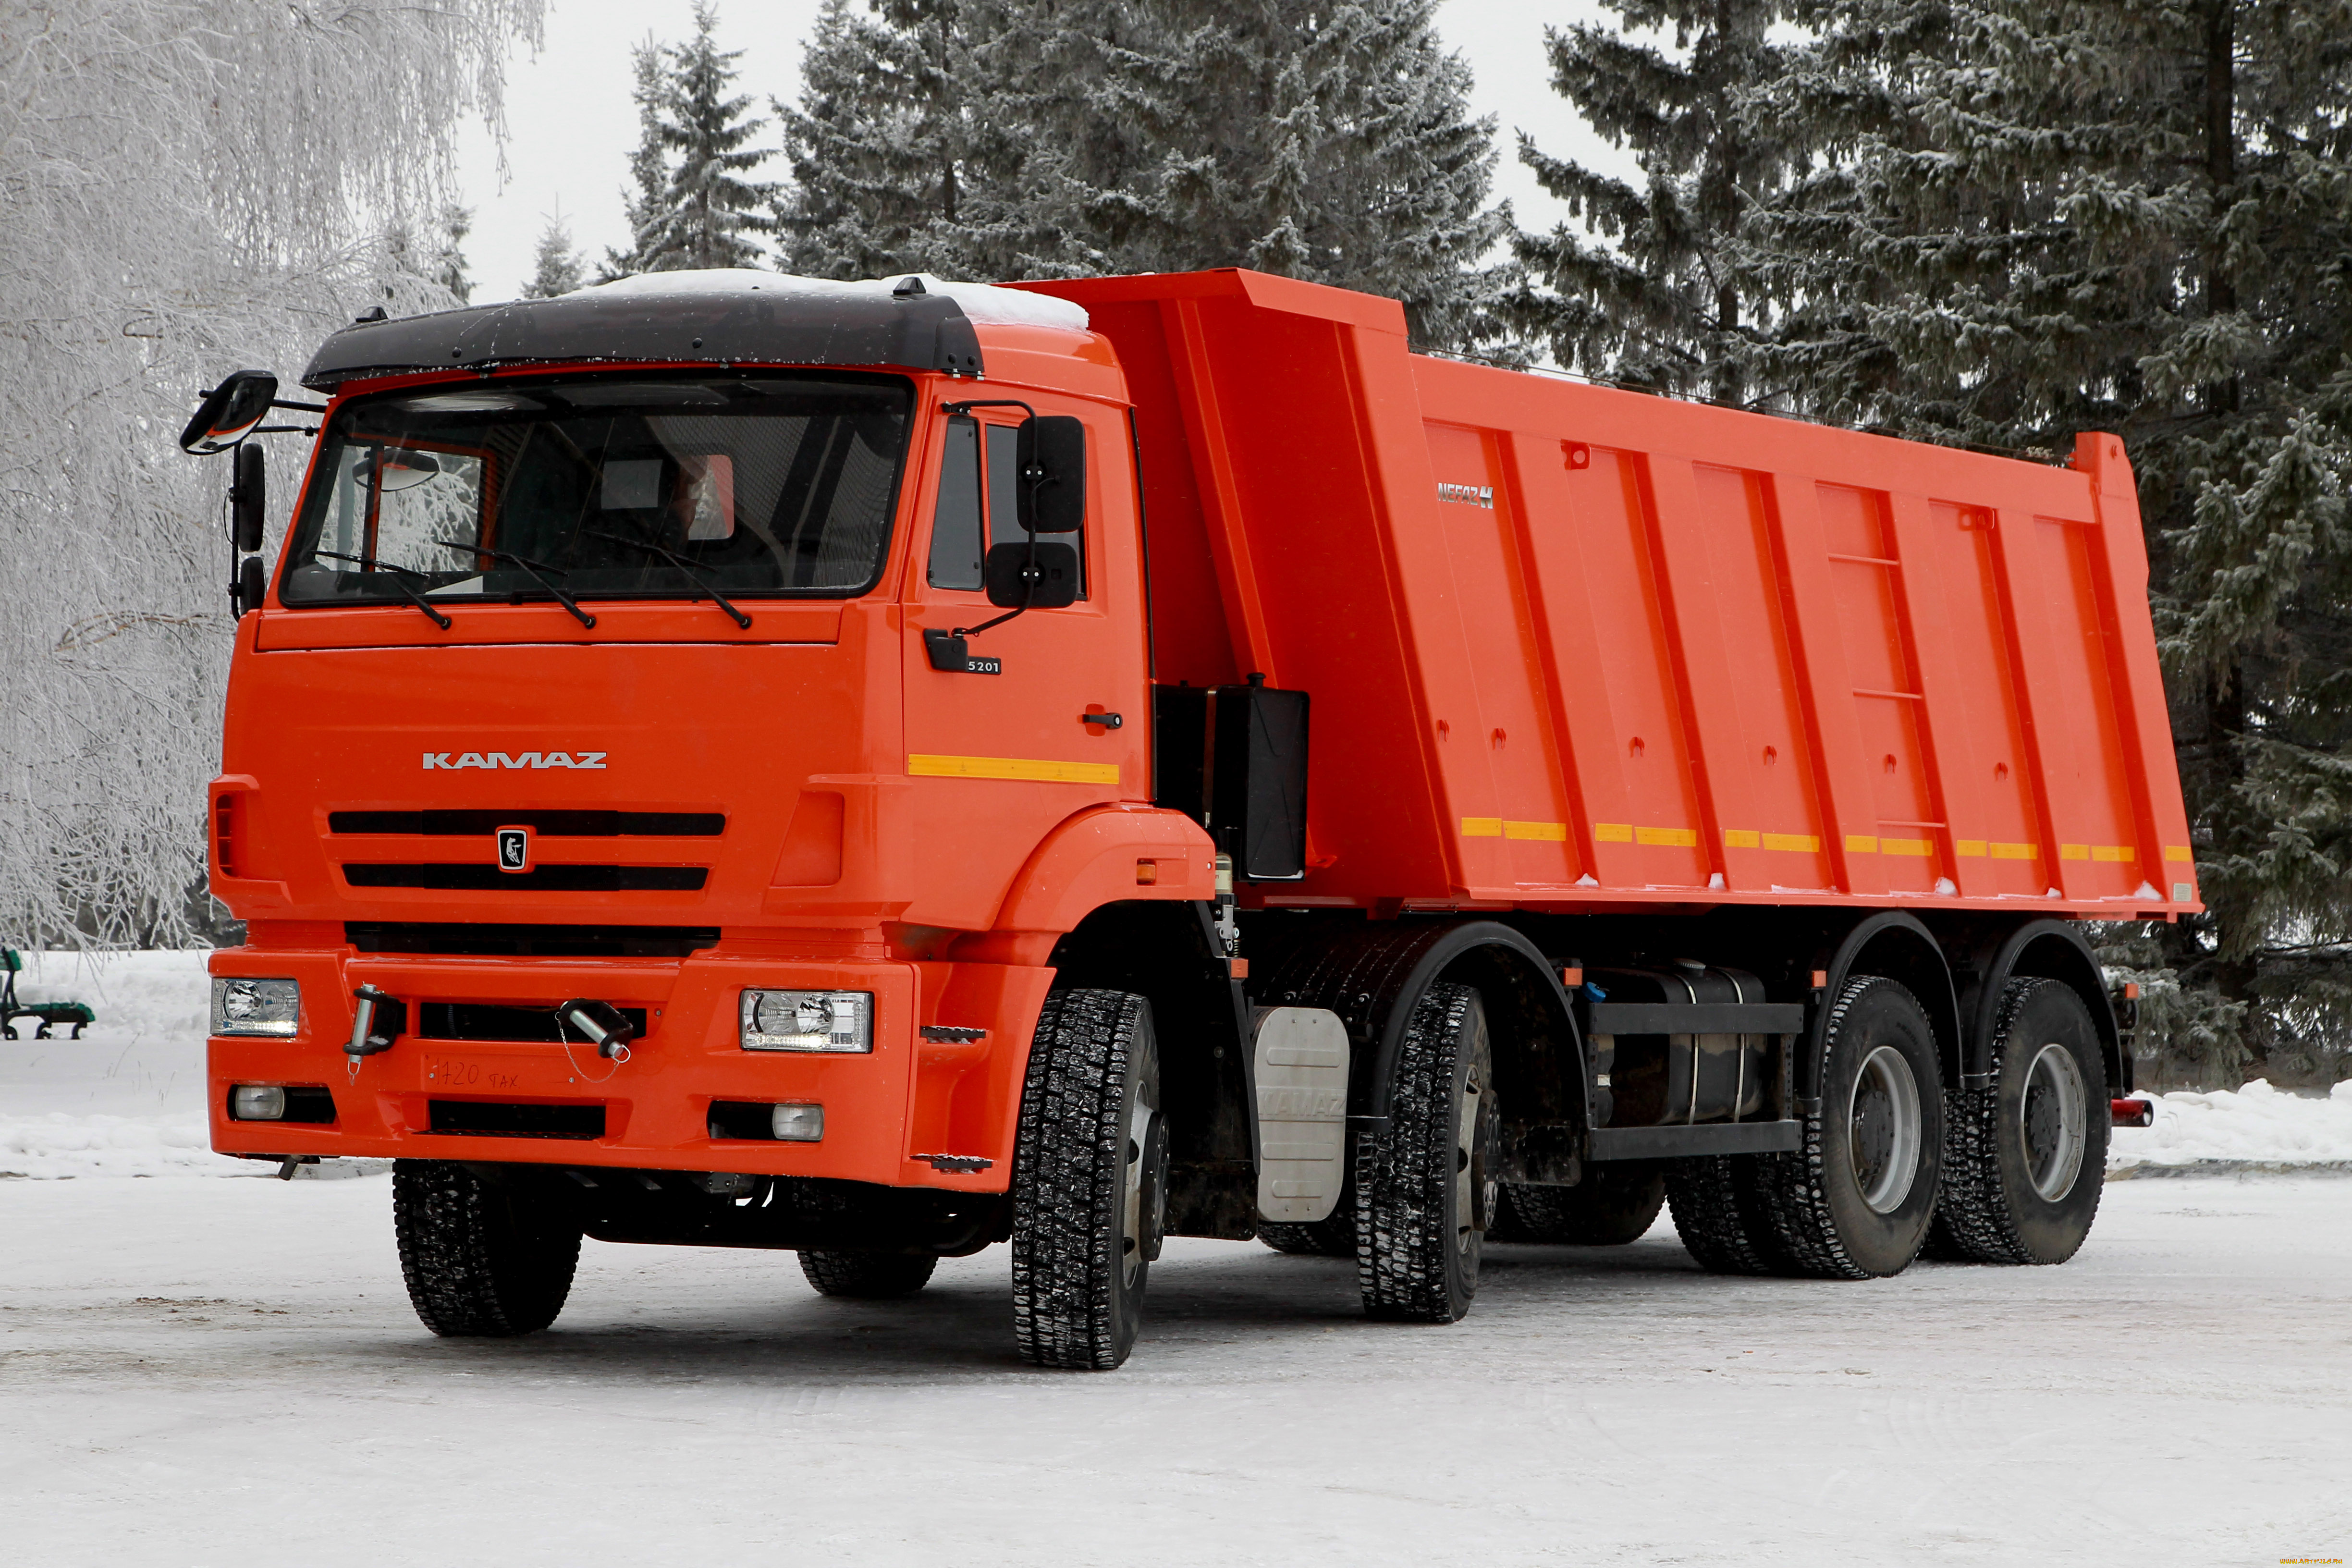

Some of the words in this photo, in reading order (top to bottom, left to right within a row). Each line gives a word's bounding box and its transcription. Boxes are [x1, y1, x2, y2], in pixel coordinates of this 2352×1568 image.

[1438, 482, 1478, 505] NEFAZ
[968, 661, 999, 672] 5201
[423, 752, 607, 769] KAMAZ
[1258, 1091, 1346, 1117] KAMAZ
